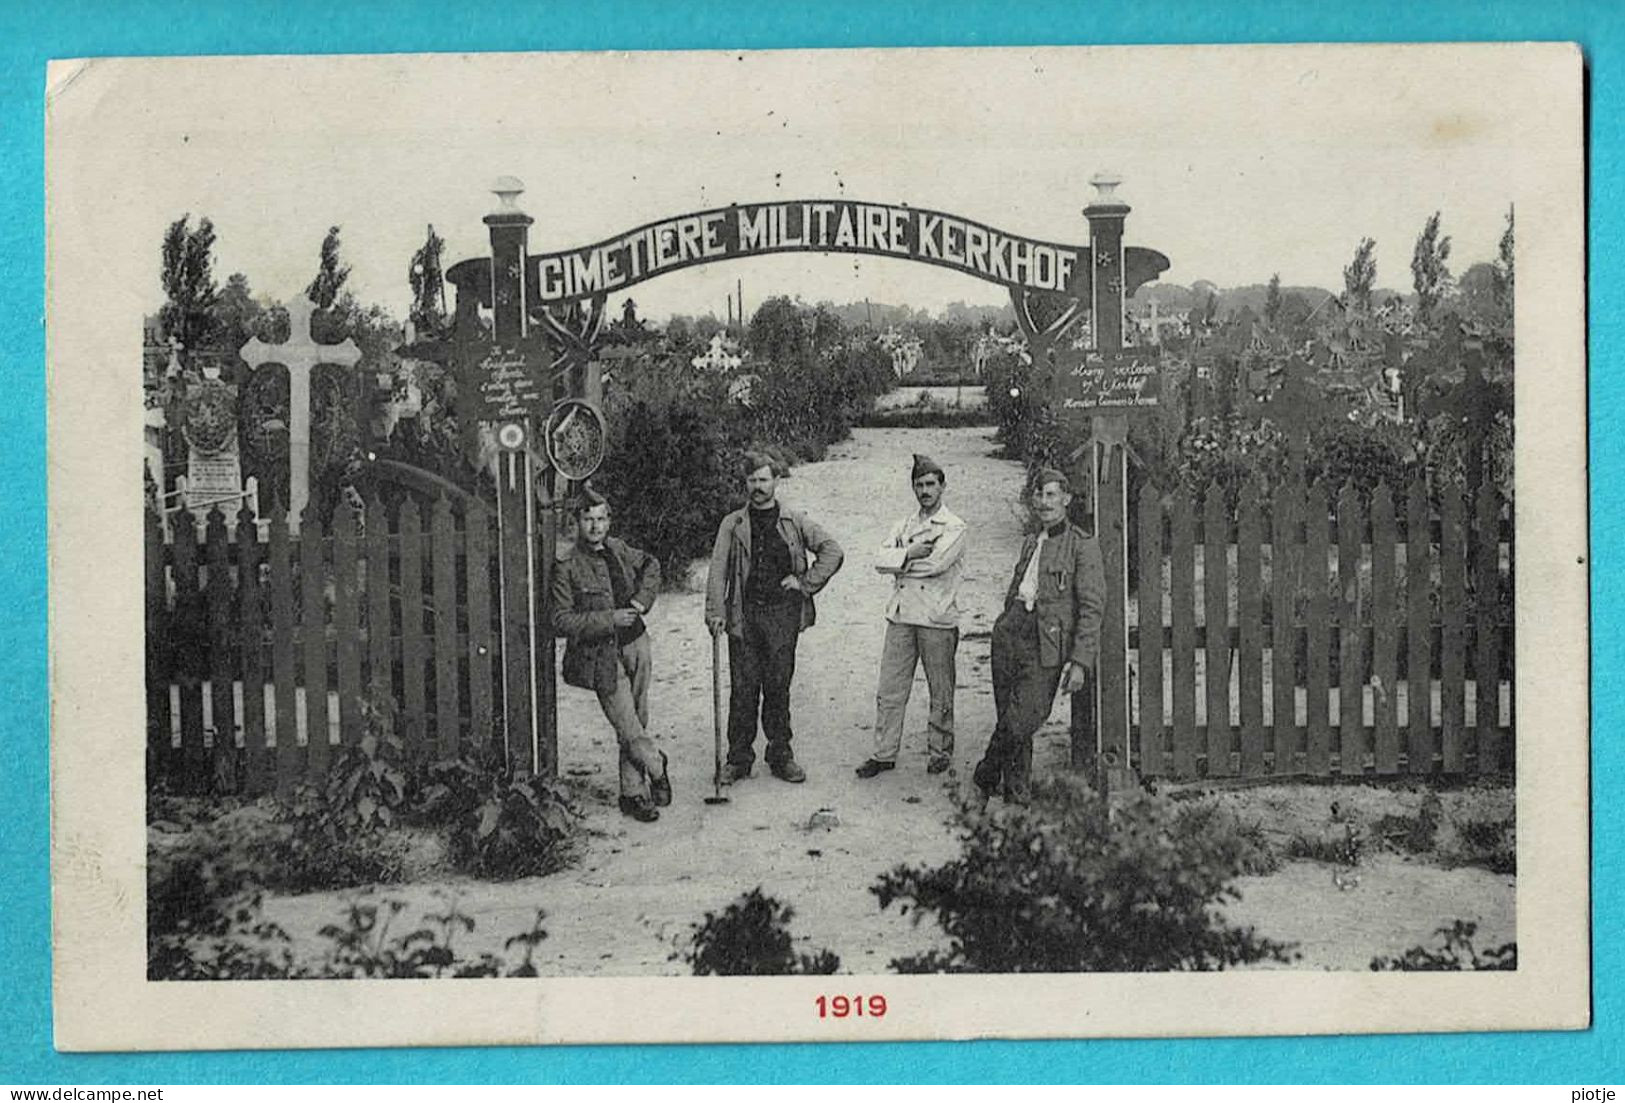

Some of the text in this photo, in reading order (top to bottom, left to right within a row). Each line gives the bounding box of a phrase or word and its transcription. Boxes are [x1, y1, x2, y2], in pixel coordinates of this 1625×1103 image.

[737, 203, 910, 255] MILITAIRE
[918, 213, 1078, 292] KERKHOF
[815, 995, 887, 1018] 1919
